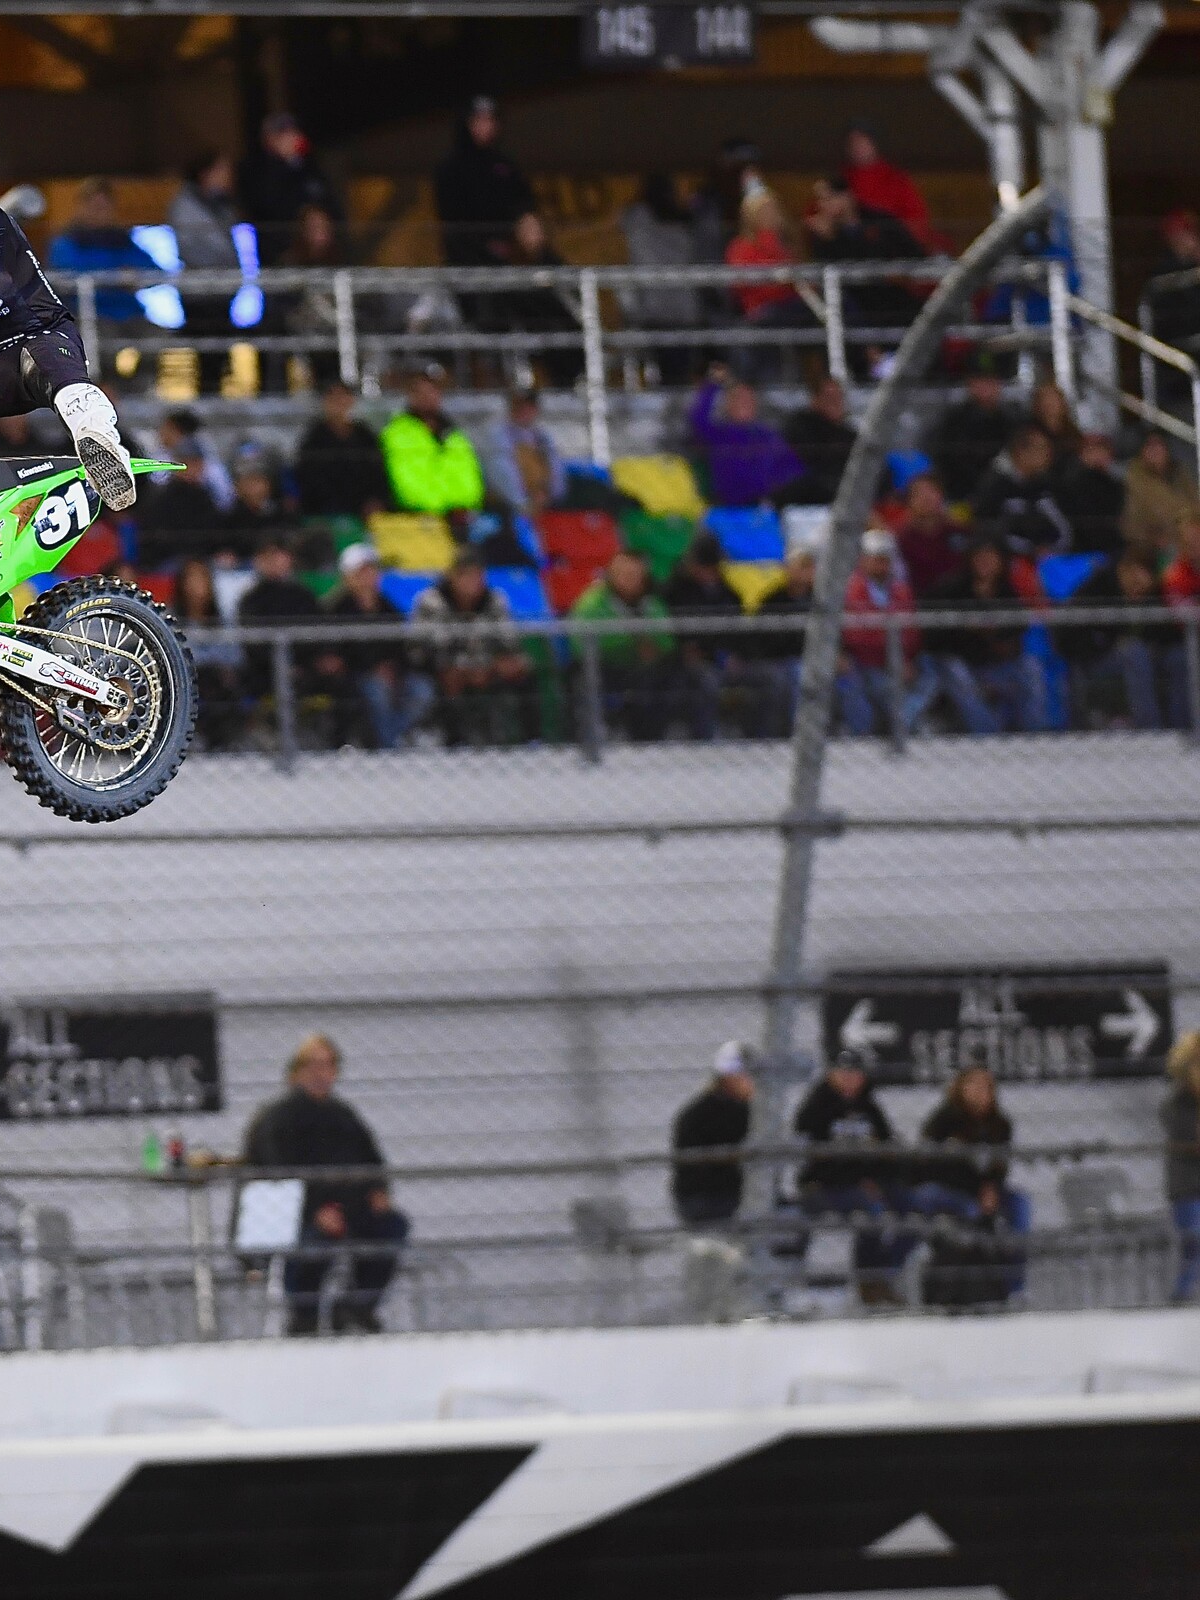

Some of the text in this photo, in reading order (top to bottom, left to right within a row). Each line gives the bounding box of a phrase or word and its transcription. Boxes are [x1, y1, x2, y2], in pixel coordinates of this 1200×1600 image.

[17, 462, 54, 479] Kawasaki
[34, 481, 91, 546] 31
[65, 598, 111, 619] DUNLOP
